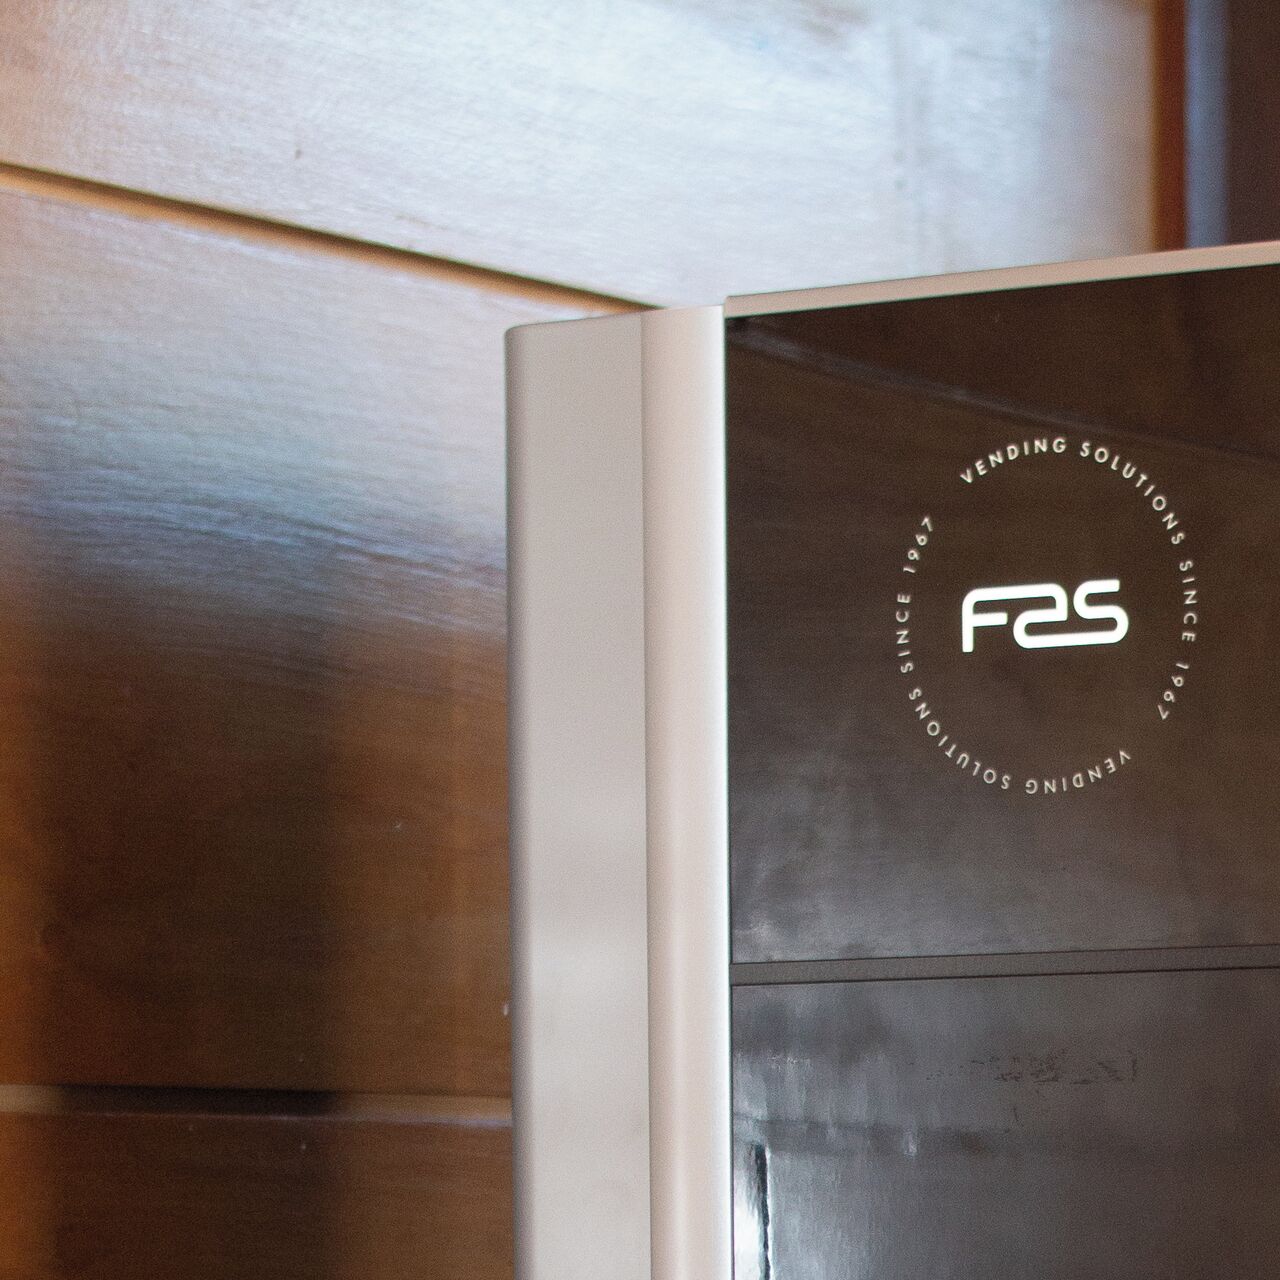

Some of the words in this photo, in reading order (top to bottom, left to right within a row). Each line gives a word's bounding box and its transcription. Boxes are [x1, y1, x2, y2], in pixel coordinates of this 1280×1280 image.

[959, 437, 1067, 484] VENDING
[1080, 442, 1185, 545] SOLUTIONS
[903, 516, 933, 574] 1967
[896, 593, 914, 674] SINCE
[1178, 560, 1198, 642] SINCE
[1157, 662, 1189, 720] 1967
[909, 687, 1011, 790] SOLUTIONS
[1025, 750, 1131, 795] VENDING
